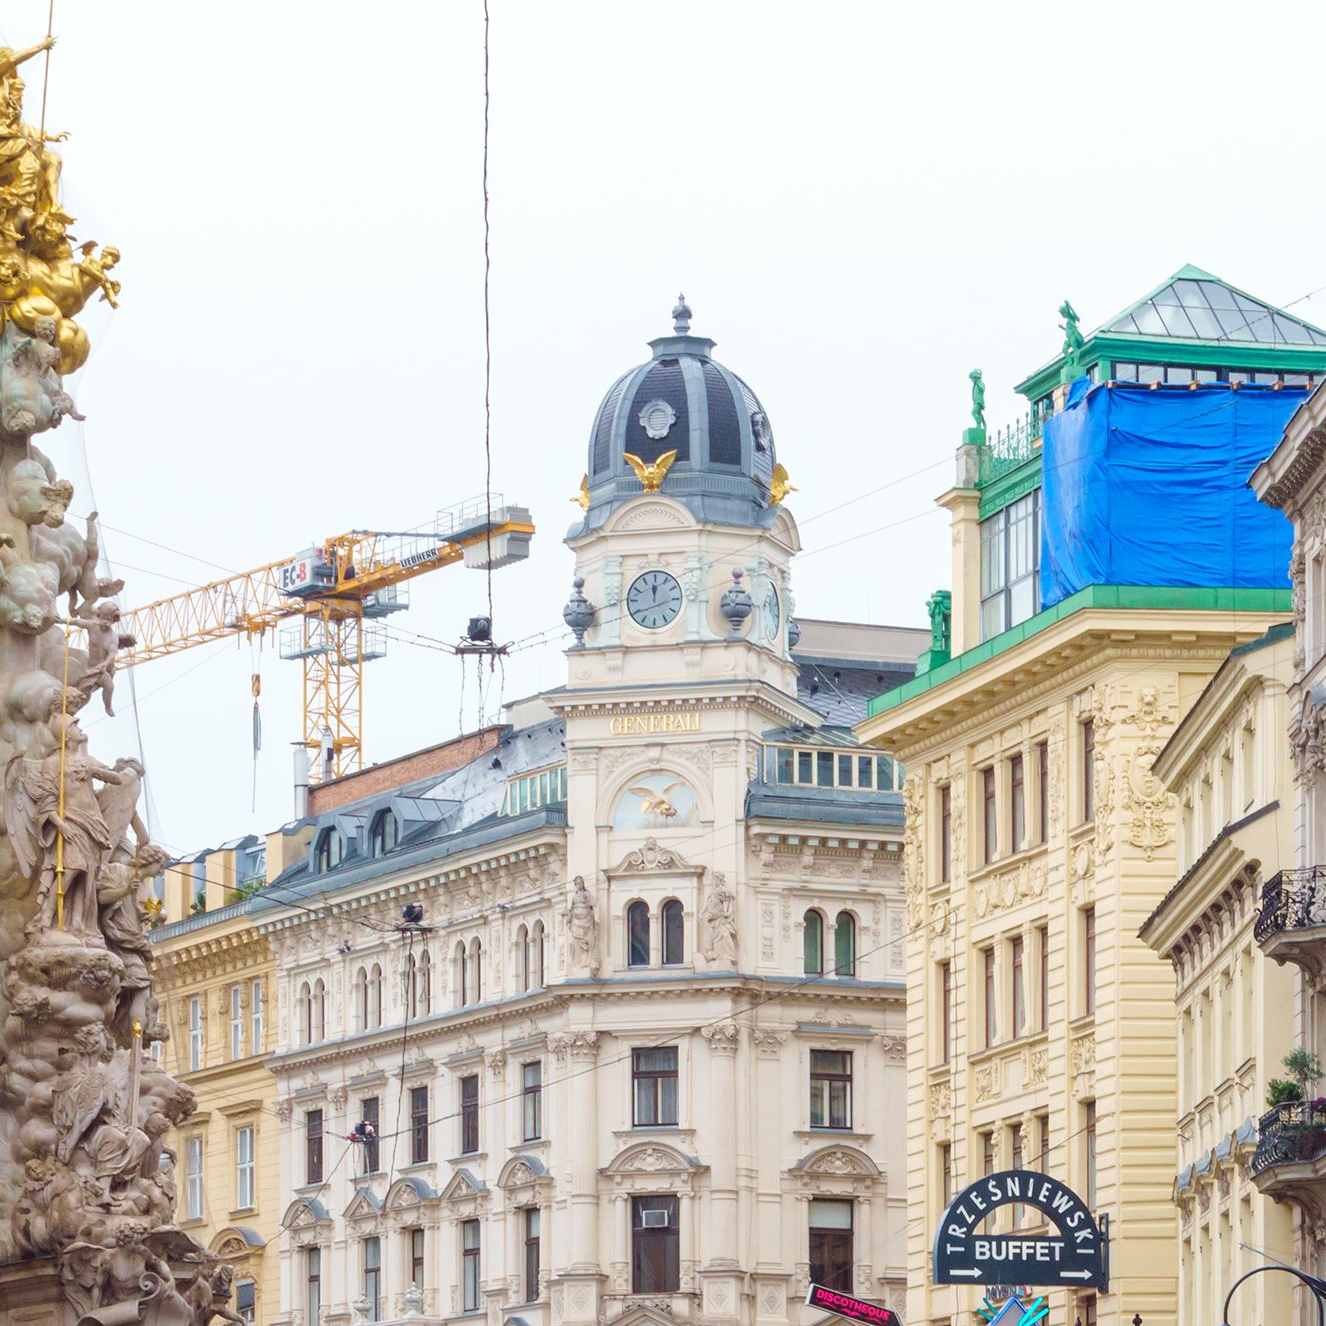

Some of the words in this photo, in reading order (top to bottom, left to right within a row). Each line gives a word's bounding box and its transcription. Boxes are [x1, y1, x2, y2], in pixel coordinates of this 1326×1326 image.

[400, 548, 437, 567] LIEBHERR
[283, 562, 306, 588] EC-B
[610, 713, 701, 736] GENERALI
[947, 1176, 1094, 1255] TRZEŚNIEWSKI
[975, 1241, 1065, 1261] BUFFET
[816, 1289, 890, 1321] DISCOTHEQUE
